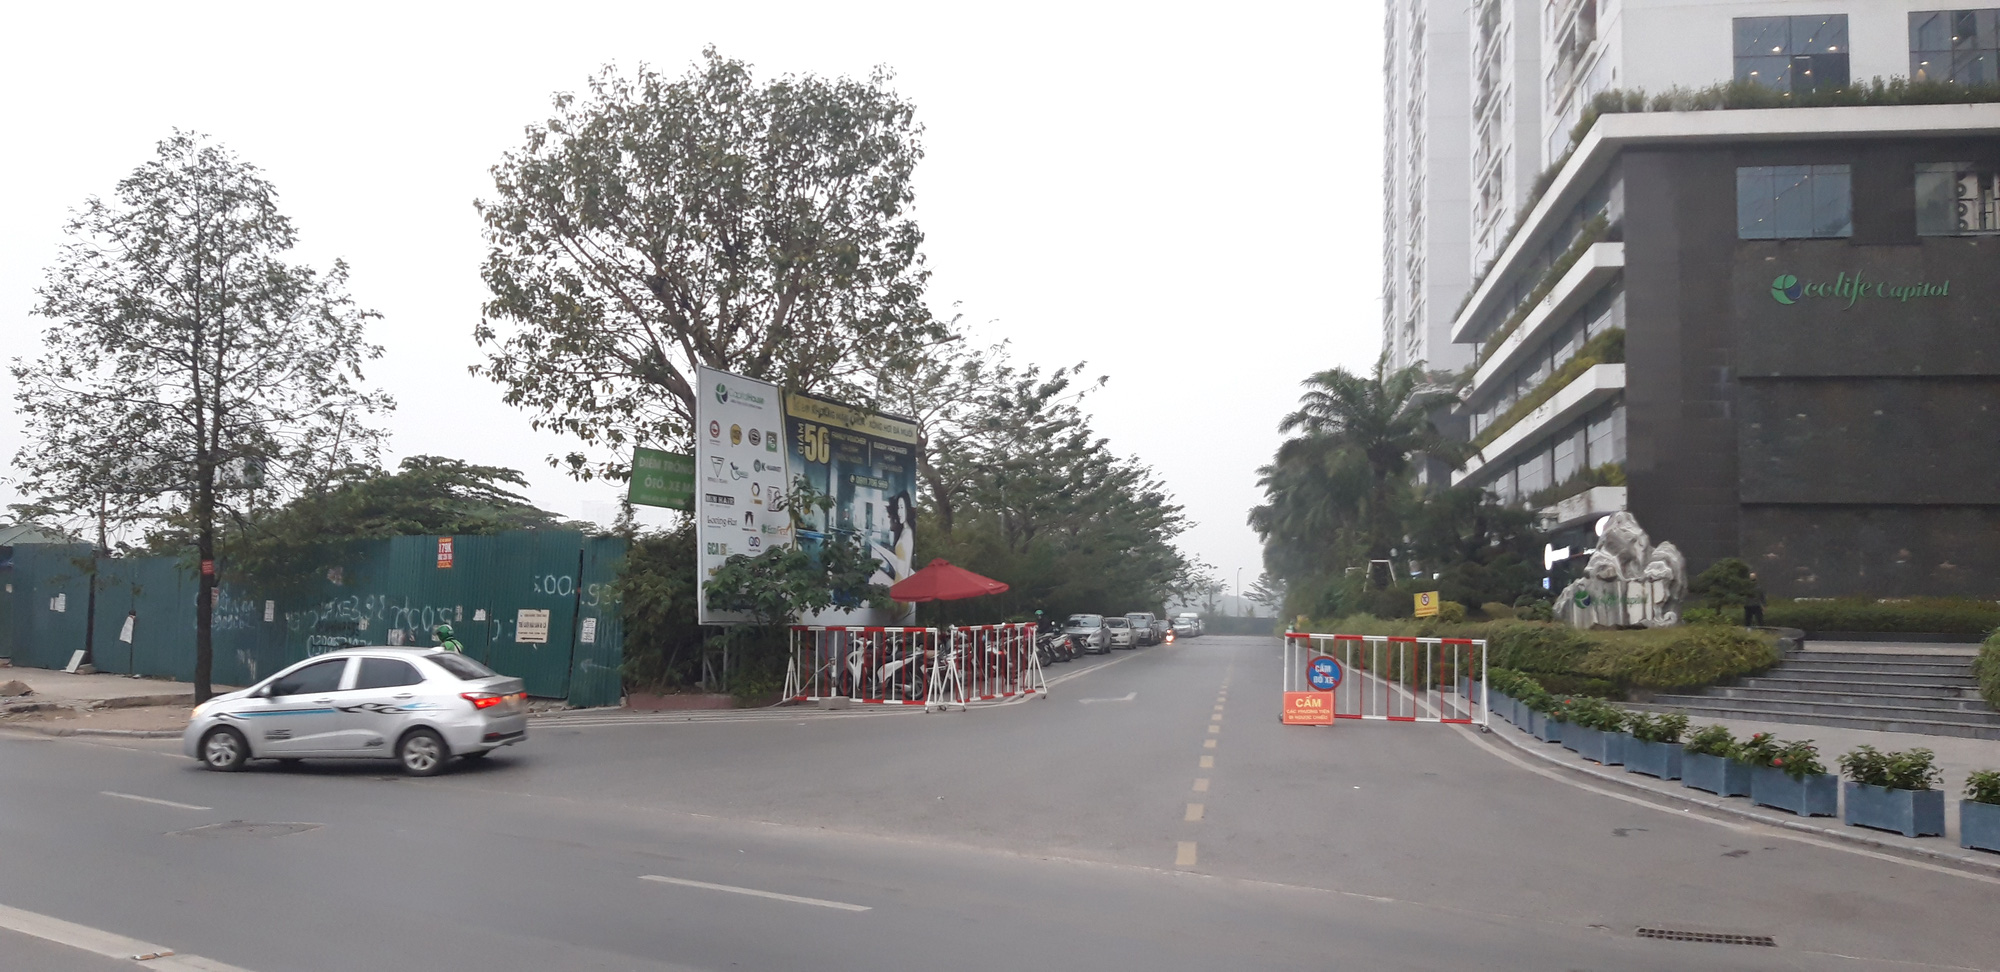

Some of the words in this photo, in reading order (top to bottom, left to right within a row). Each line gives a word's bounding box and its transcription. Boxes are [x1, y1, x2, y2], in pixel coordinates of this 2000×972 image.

[1876, 280, 1949, 302] Capitol
[1324, 676, 1334, 684] XE
[1295, 695, 1321, 707] CẤM
